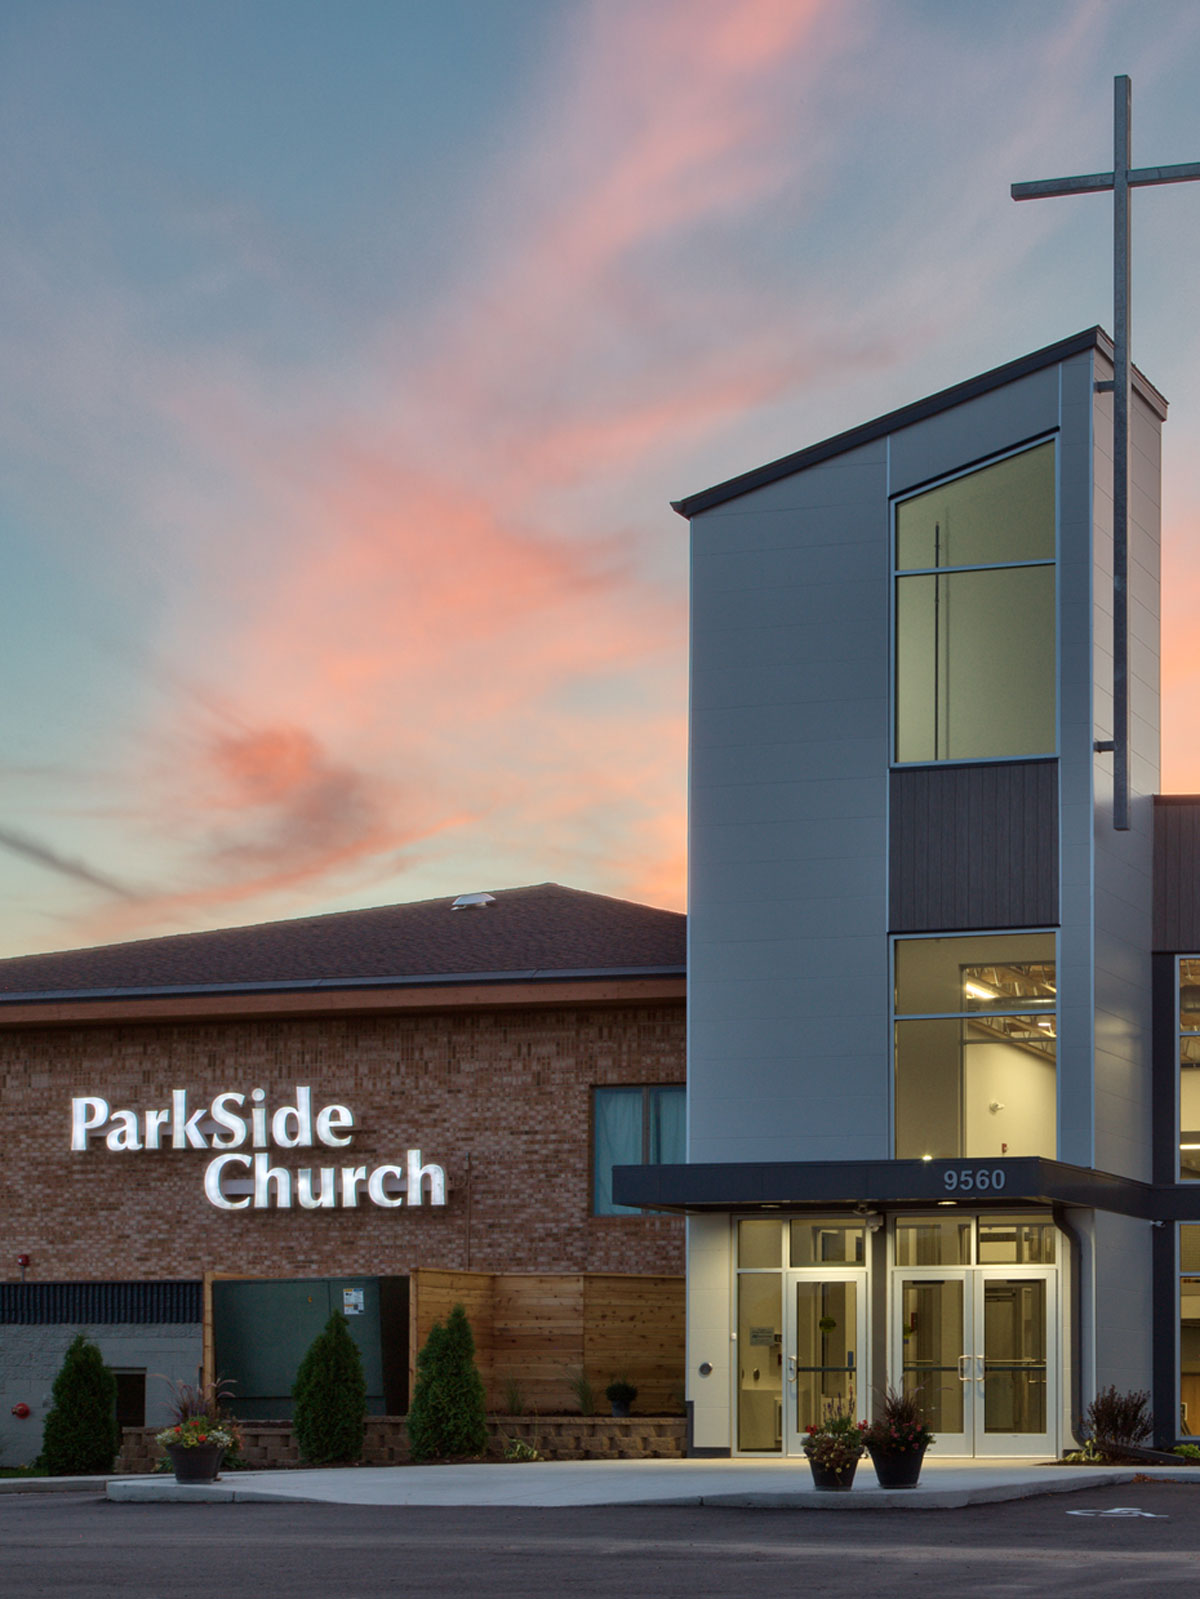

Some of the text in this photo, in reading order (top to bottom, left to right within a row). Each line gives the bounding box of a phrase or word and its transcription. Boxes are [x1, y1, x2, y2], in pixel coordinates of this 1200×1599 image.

[70, 1086, 354, 1151] ParkSide
[203, 1149, 446, 1210] Church
[943, 1168, 1006, 1191] 9560
